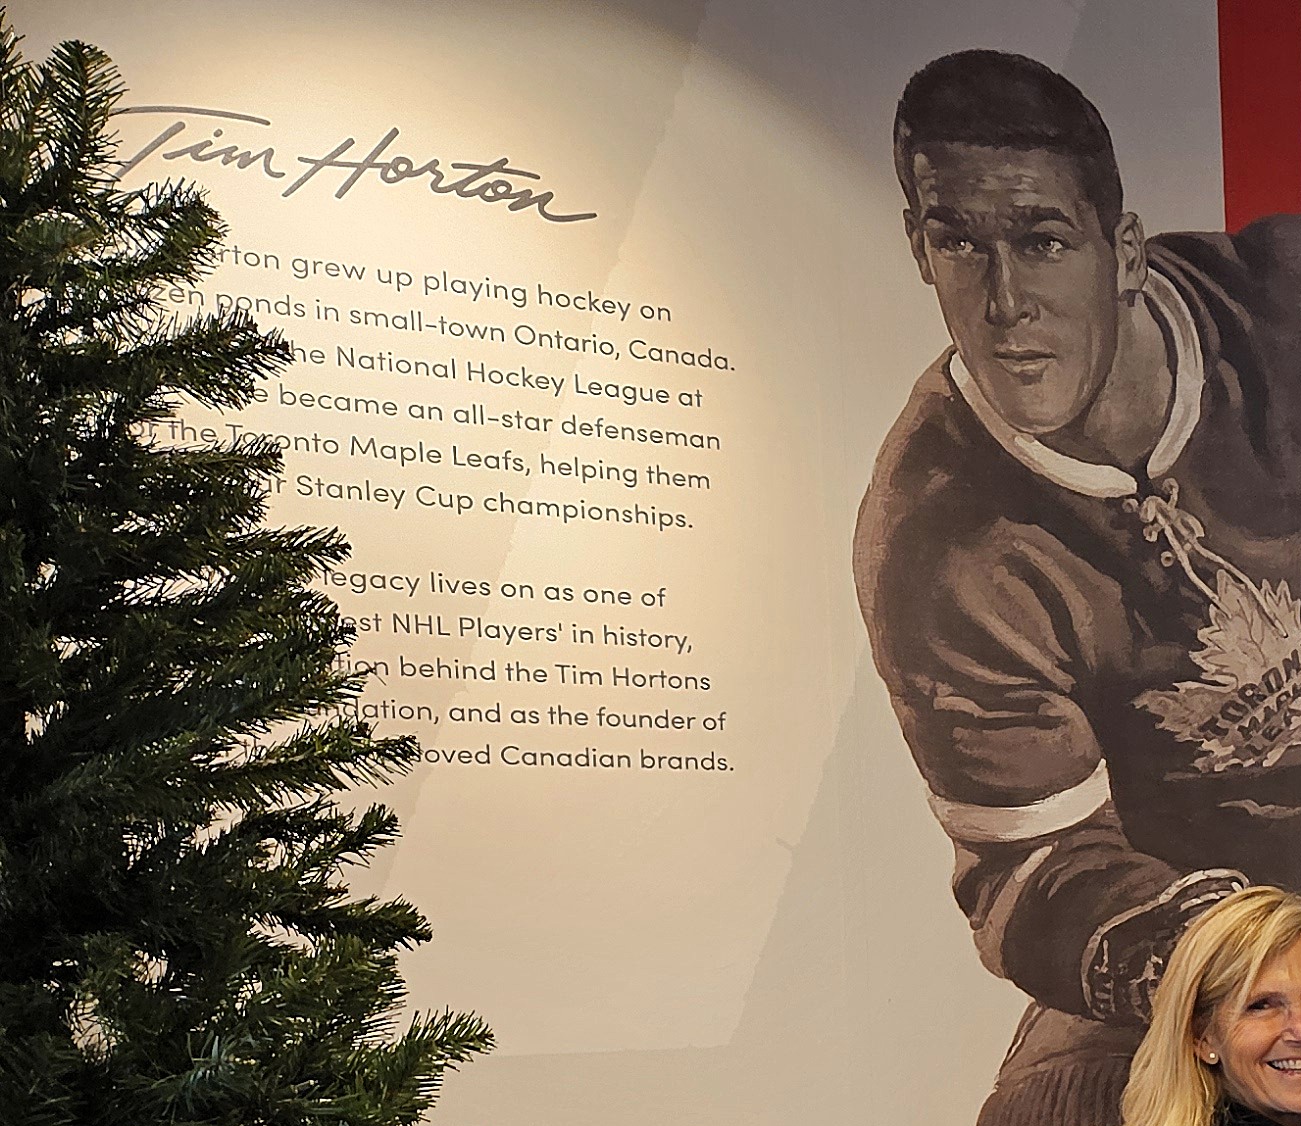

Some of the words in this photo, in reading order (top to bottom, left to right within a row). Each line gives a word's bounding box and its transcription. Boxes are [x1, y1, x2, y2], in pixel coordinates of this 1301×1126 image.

[108, 105, 285, 187] Tim
[281, 127, 597, 222] Horton
[291, 256, 366, 281] grew
[377, 268, 413, 293] up
[424, 271, 528, 308] playing
[538, 284, 631, 322] hockey
[640, 304, 672, 322] on
[217, 293, 306, 319] ponds
[316, 299, 340, 323] in
[350, 309, 505, 343] small-town
[514, 324, 621, 361] Ontario,
[629, 339, 736, 371] Canada.
[290, 340, 326, 364] he
[336, 345, 457, 380] National
[467, 360, 565, 398] Hockey
[575, 373, 671, 406] League
[678, 389, 703, 408] at
[279, 383, 398, 416] became
[408, 403, 443, 422] an
[453, 404, 553, 432] all-star
[561, 414, 721, 451] defenseman
[168, 418, 218, 443] the
[350, 435, 442, 467] Maple
[452, 445, 532, 477] Leafs,
[540, 453, 638, 488] helping
[645, 465, 711, 490] them
[296, 474, 406, 509] Stanley
[416, 485, 474, 515] Cup
[483, 492, 694, 532] championships.
[323, 570, 421, 598] legacy
[430, 571, 492, 596] lives
[500, 583, 535, 599] on
[544, 585, 575, 602] as
[583, 588, 632, 605] one
[641, 587, 667, 608] of
[392, 612, 451, 637] NHL
[459, 616, 563, 646] Players'
[572, 623, 595, 644] in
[603, 624, 693, 655] history,
[399, 655, 496, 682] behind
[505, 661, 548, 683] the
[555, 663, 603, 686] Tim
[612, 667, 712, 691] Hortons
[448, 702, 502, 724] and
[510, 709, 541, 725] as
[547, 705, 589, 727] the
[596, 706, 697, 731] founder
[702, 711, 728, 731] of
[500, 745, 633, 769] Canadian
[640, 748, 735, 772] brands.
